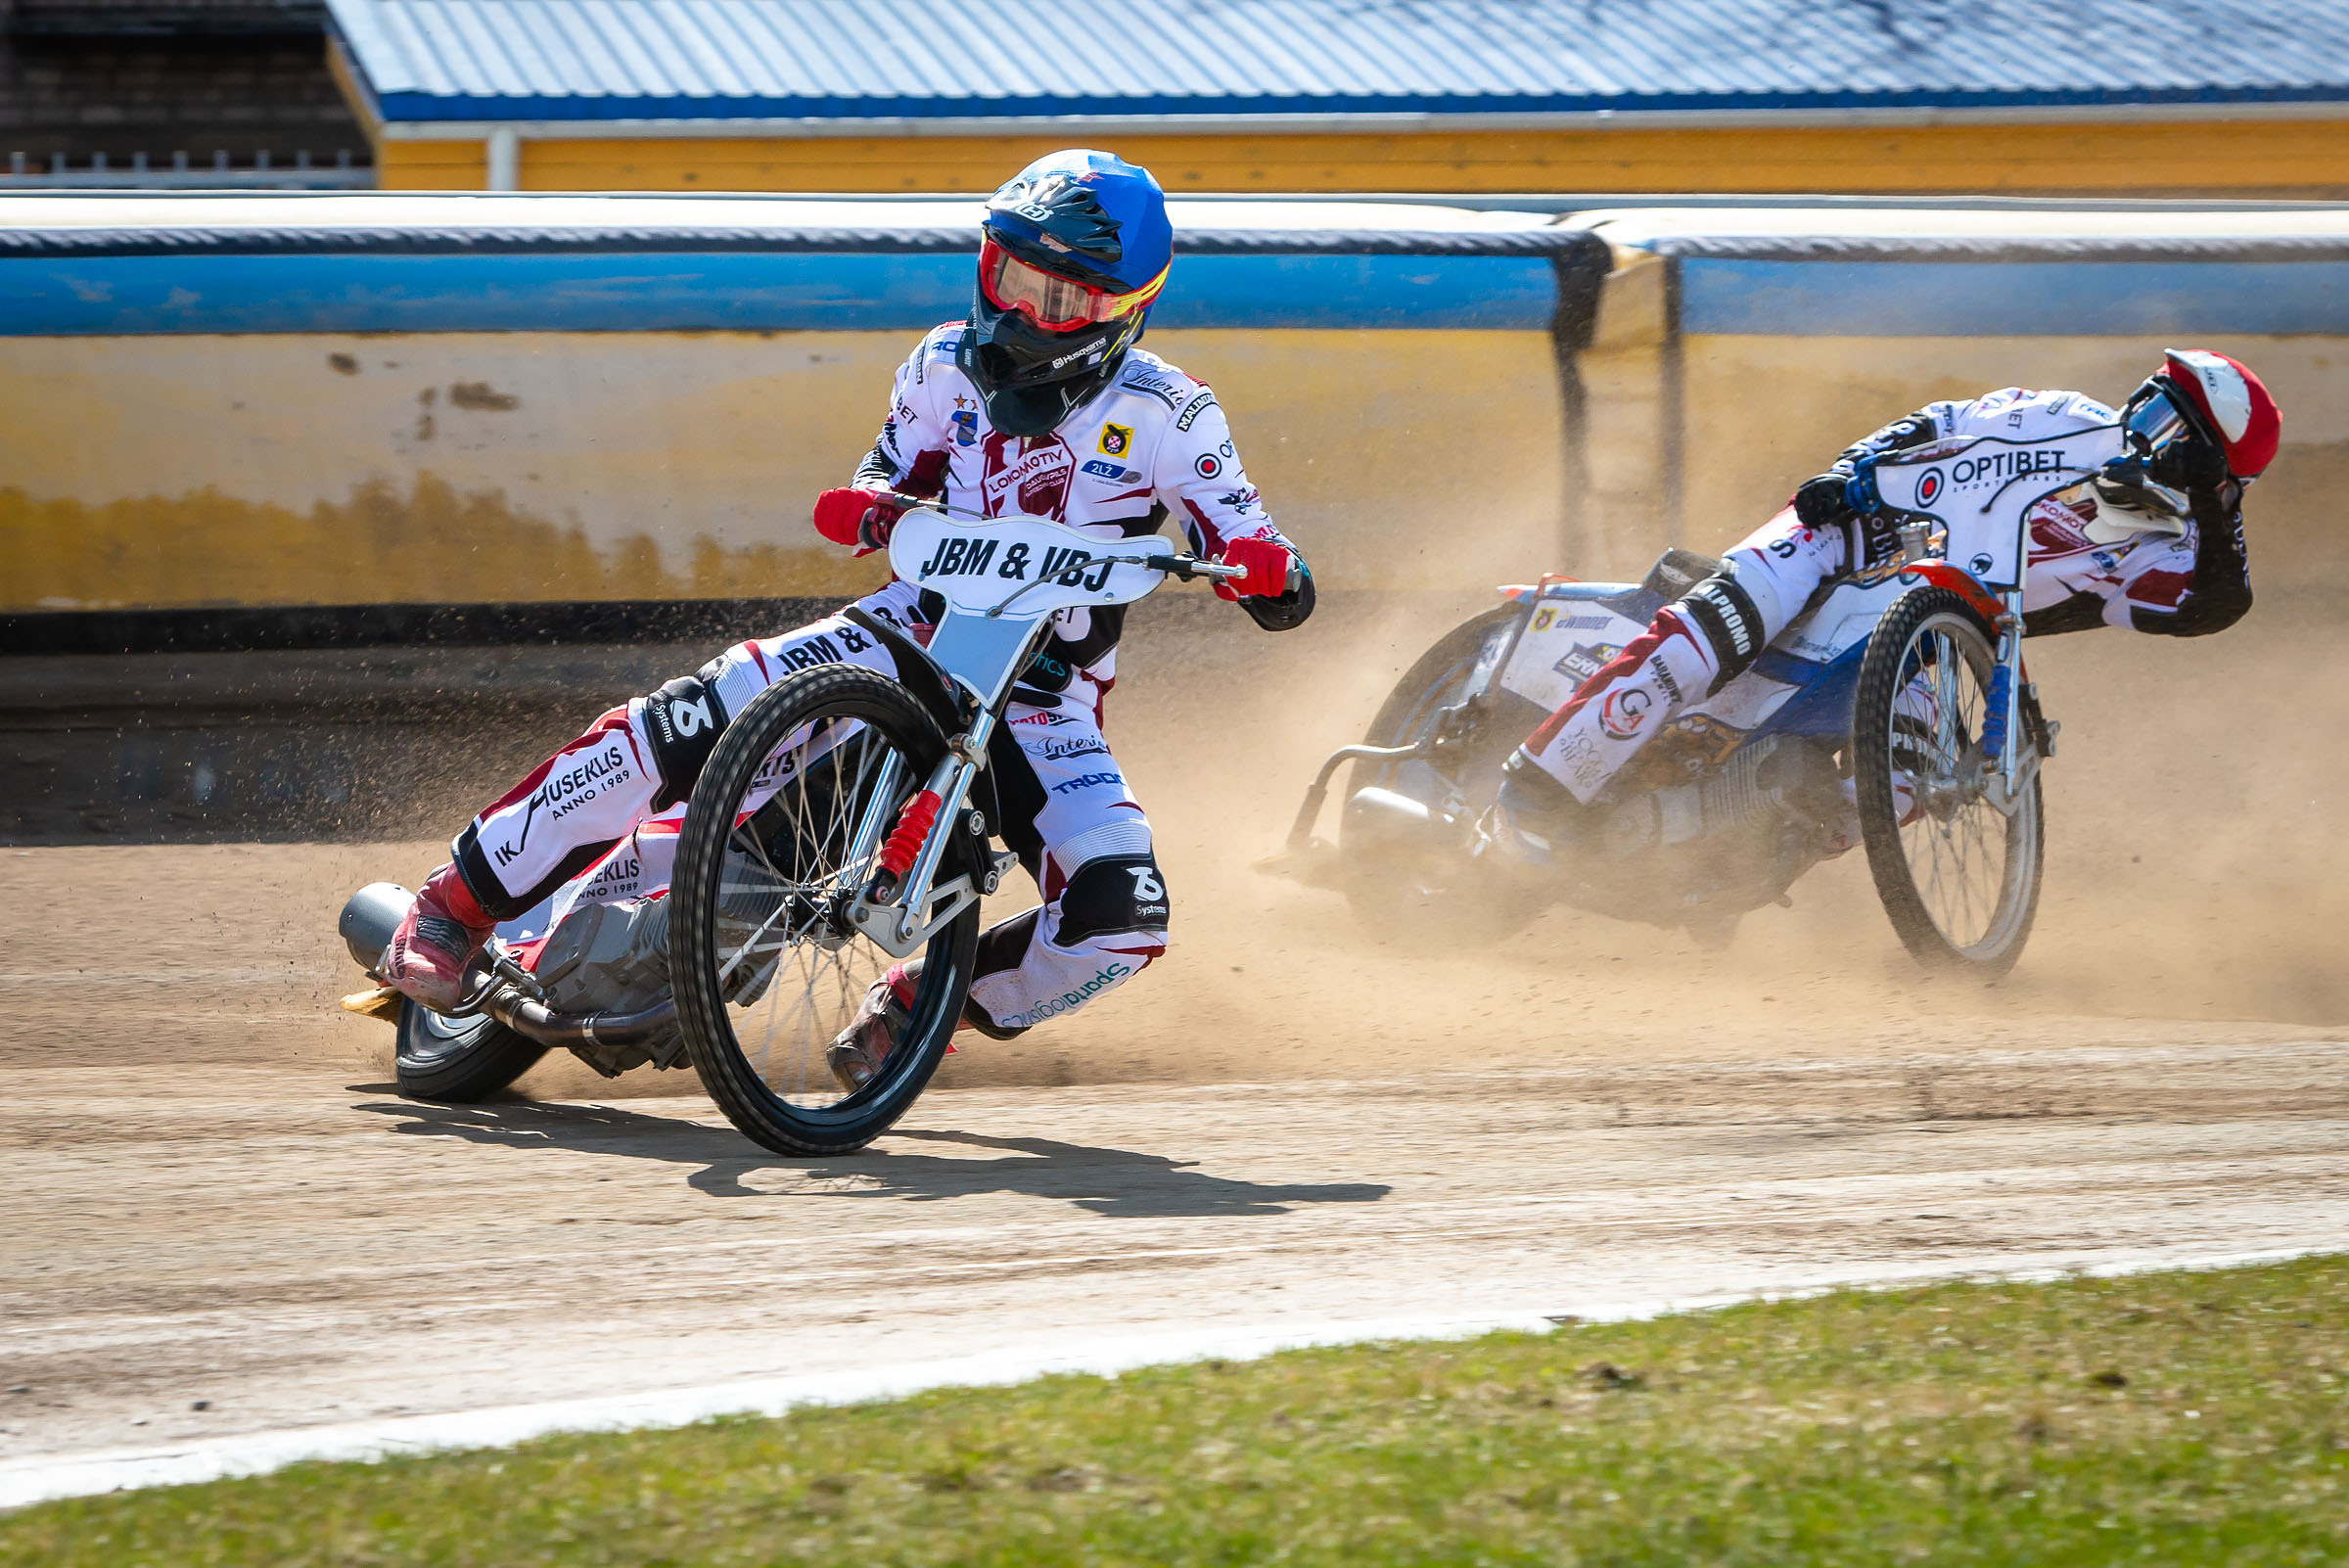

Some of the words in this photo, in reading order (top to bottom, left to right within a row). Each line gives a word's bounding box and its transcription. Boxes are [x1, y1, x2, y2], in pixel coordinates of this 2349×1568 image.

[1063, 336, 1107, 365] Husqvarna
[1953, 450, 2065, 484] OPTIBET
[921, 537, 1000, 577] JBM
[997, 542, 1032, 580] &
[1037, 545, 1115, 593] VBJ
[834, 625, 873, 654] &
[655, 703, 674, 744] Systems
[551, 789, 597, 821] ANNO
[601, 770, 630, 792] 1989
[613, 882, 638, 895] 1989
[1135, 903, 1167, 917] Systems
